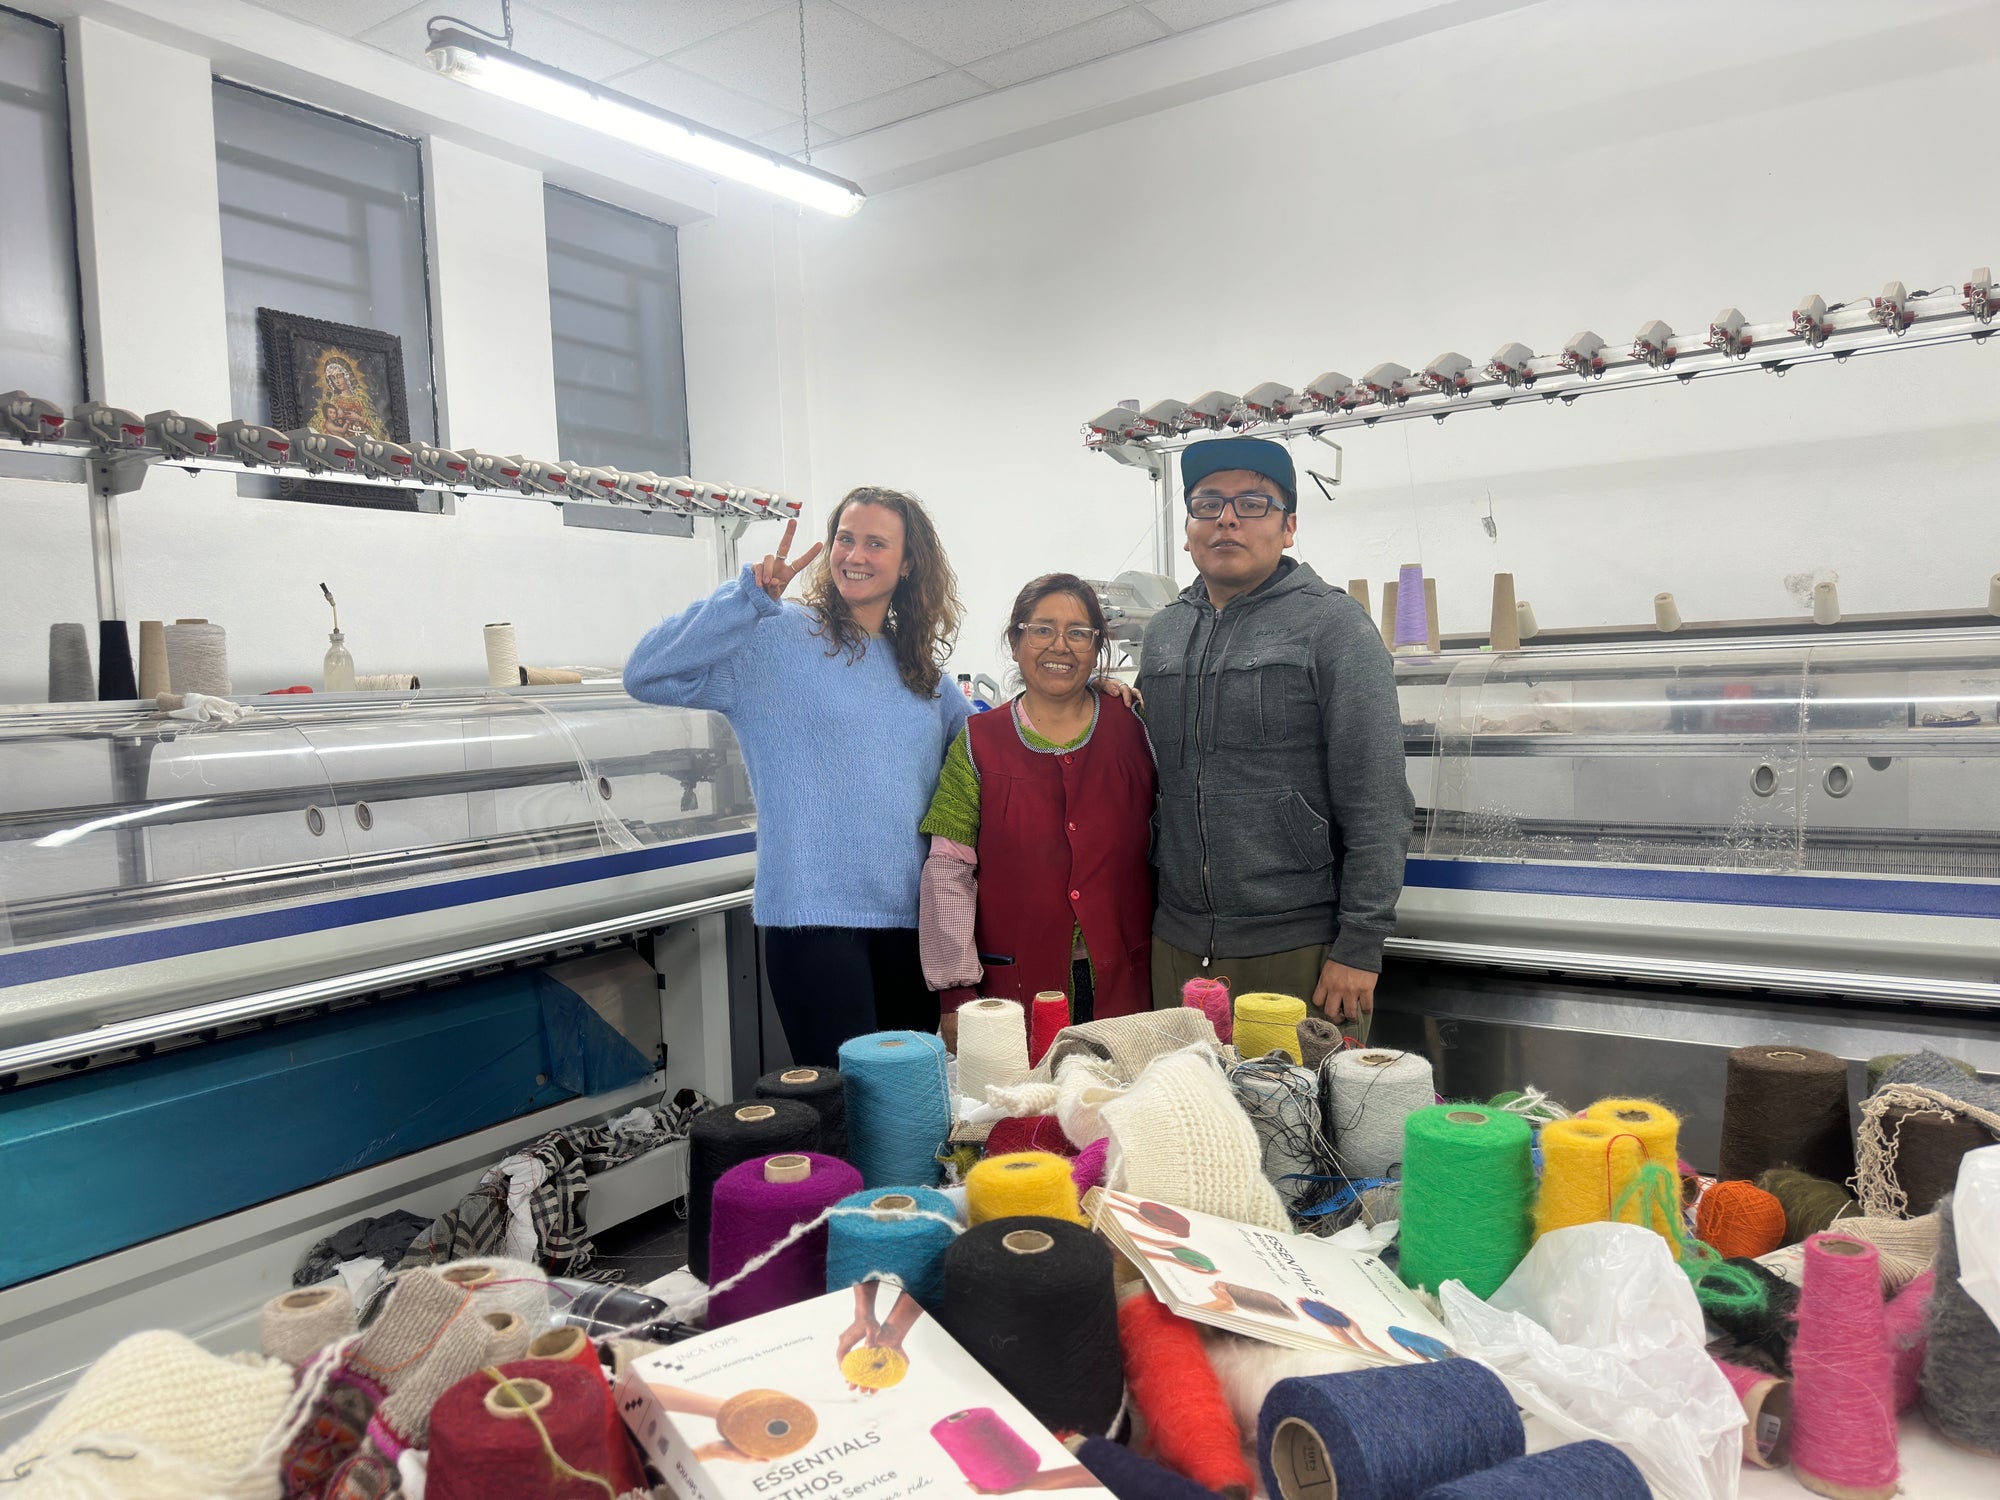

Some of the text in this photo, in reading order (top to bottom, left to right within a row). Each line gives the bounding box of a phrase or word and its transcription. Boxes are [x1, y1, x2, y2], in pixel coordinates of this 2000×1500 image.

[1264, 1234, 1325, 1296] ESSENTIALS
[676, 1336, 739, 1362] INCA TOPS
[723, 1355, 754, 1369] Knitting
[752, 1431, 881, 1492] ESSENTIALS
[768, 1470, 843, 1500] THOS
[842, 1471, 897, 1498] Service
